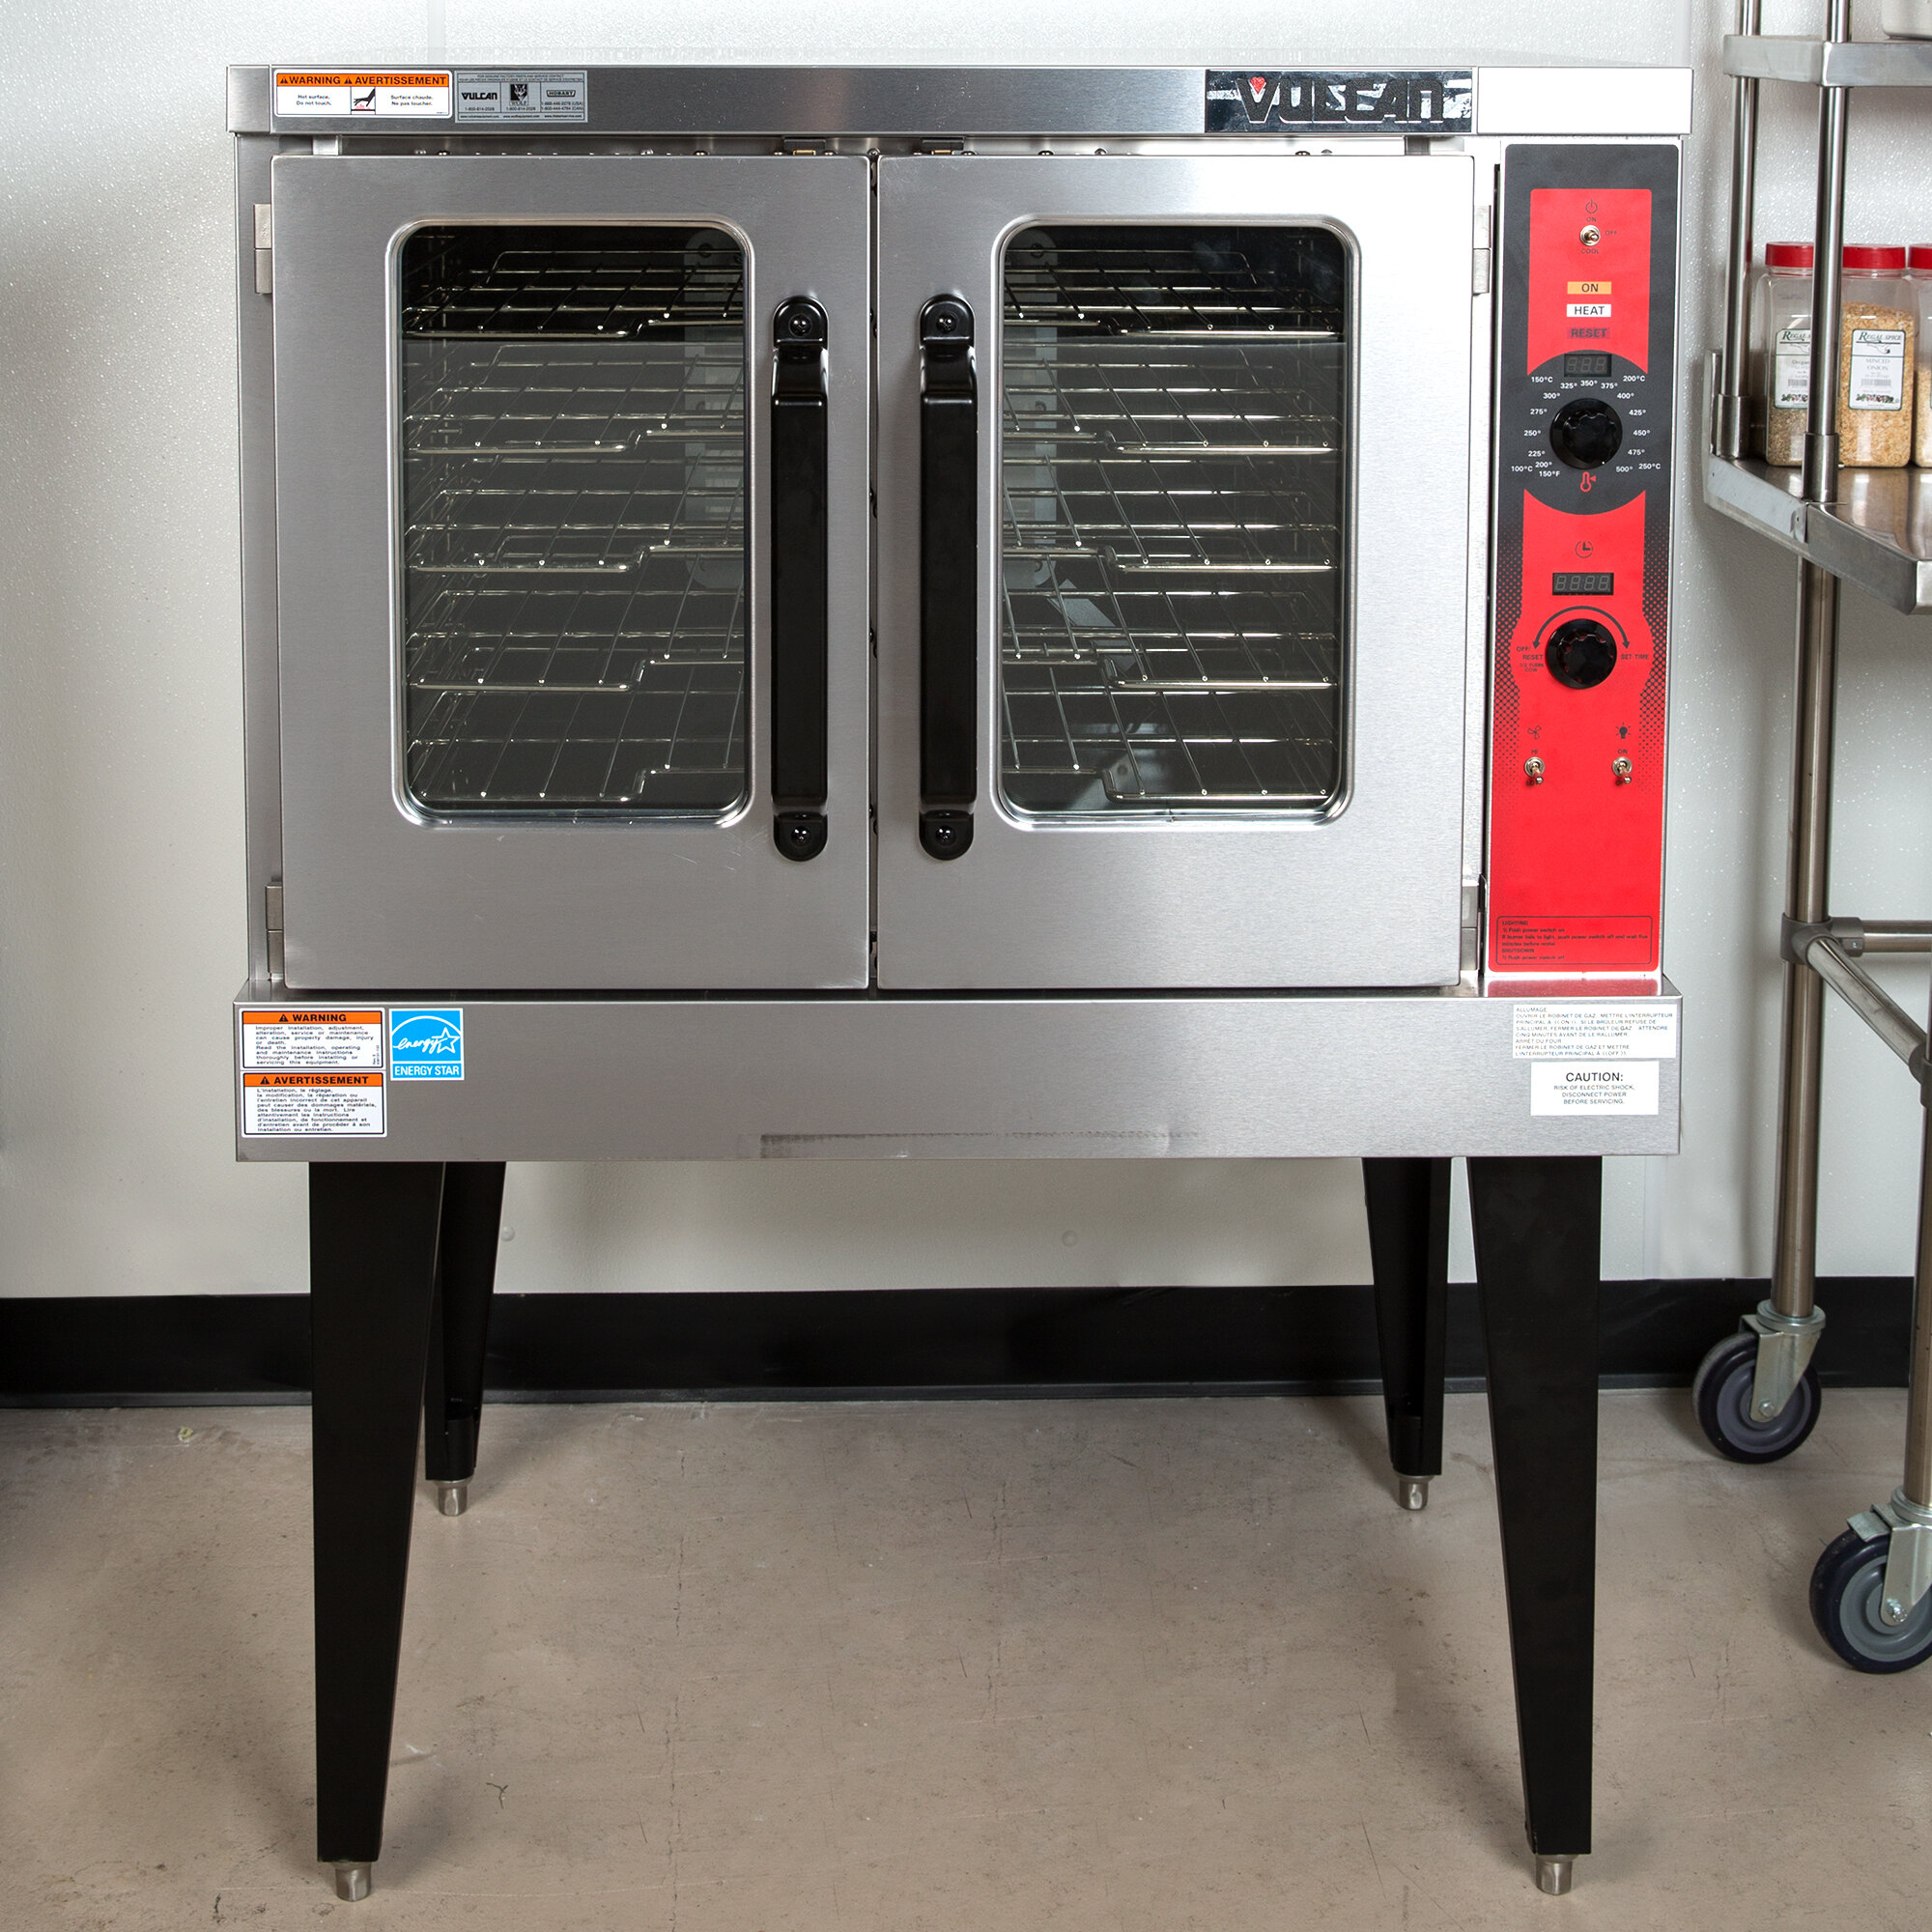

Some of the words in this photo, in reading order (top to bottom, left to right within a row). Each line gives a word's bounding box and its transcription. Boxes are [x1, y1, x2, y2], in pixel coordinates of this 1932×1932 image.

[290, 76, 341, 85] WARNING
[355, 76, 446, 85] AVERTISSEMENT
[1237, 77, 1443, 124] VULCAN
[1581, 284, 1599, 293] ON
[1574, 306, 1605, 315] HEAT
[1571, 328, 1607, 337] RESET
[1859, 331, 1883, 341] REGAL
[393, 1038, 440, 1054] energy
[394, 1065, 433, 1076] ENERGY
[435, 1065, 460, 1075] STAR
[274, 1076, 369, 1085] AVERTISSEMENT
[1565, 1072, 1624, 1082] CAUTION:
